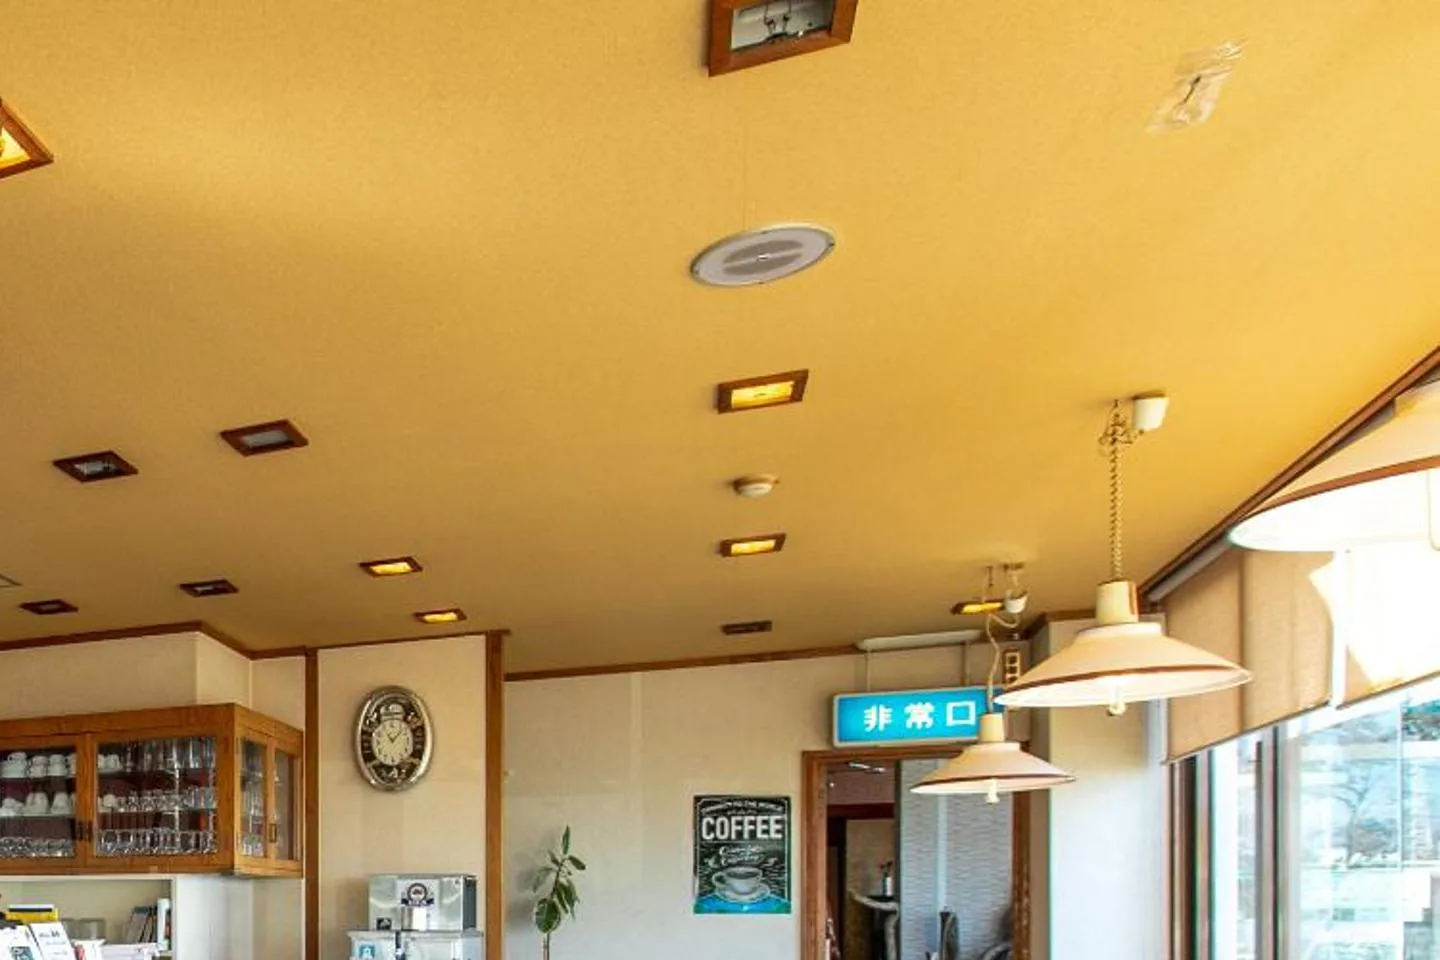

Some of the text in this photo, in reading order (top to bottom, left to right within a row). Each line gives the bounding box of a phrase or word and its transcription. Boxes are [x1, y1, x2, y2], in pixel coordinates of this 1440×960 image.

[863, 701, 977, 732] 非常口
[701, 815, 783, 840] COFFEE
